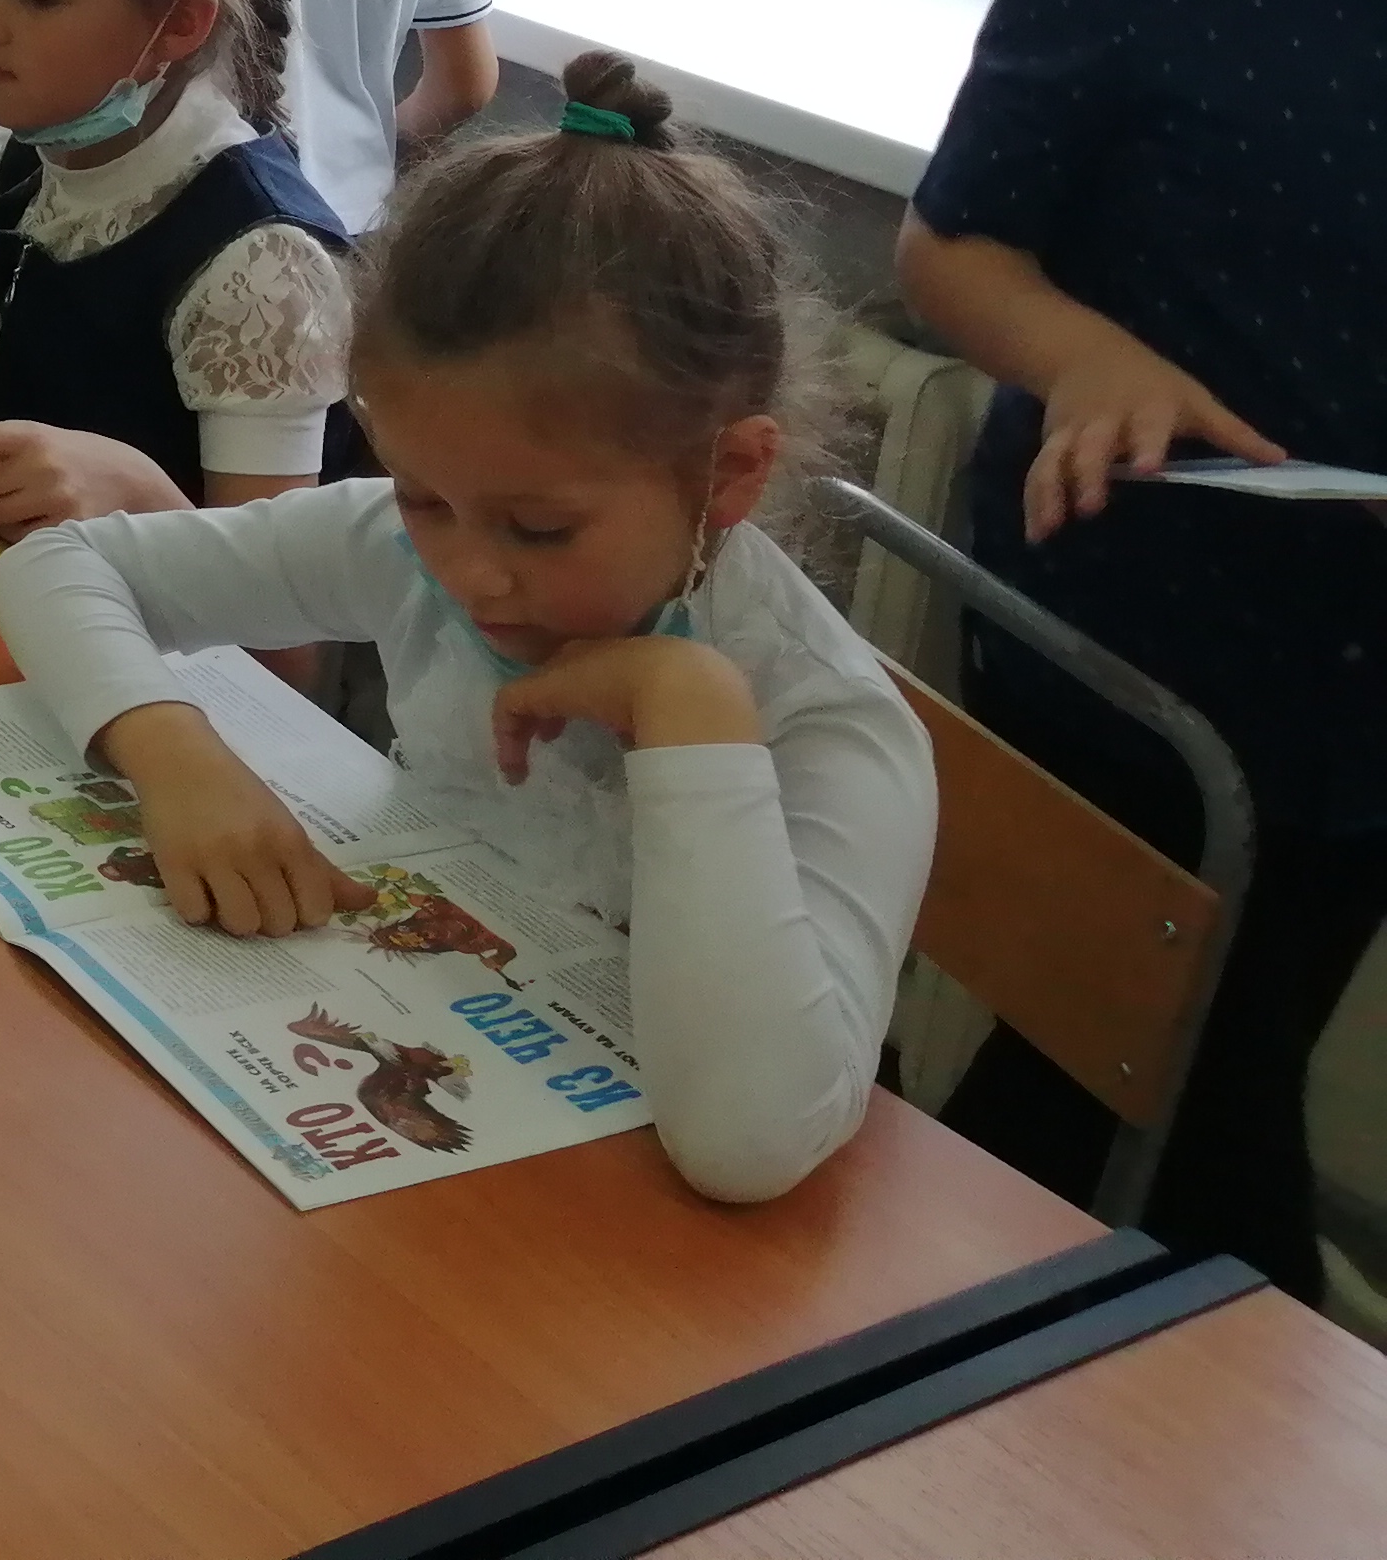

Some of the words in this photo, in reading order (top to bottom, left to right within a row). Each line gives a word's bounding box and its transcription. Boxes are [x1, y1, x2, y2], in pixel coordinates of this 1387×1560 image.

[449, 992, 569, 1065] ЧЕГО
[546, 1065, 643, 1113] ИЗ
[286, 1102, 402, 1171] КТО
